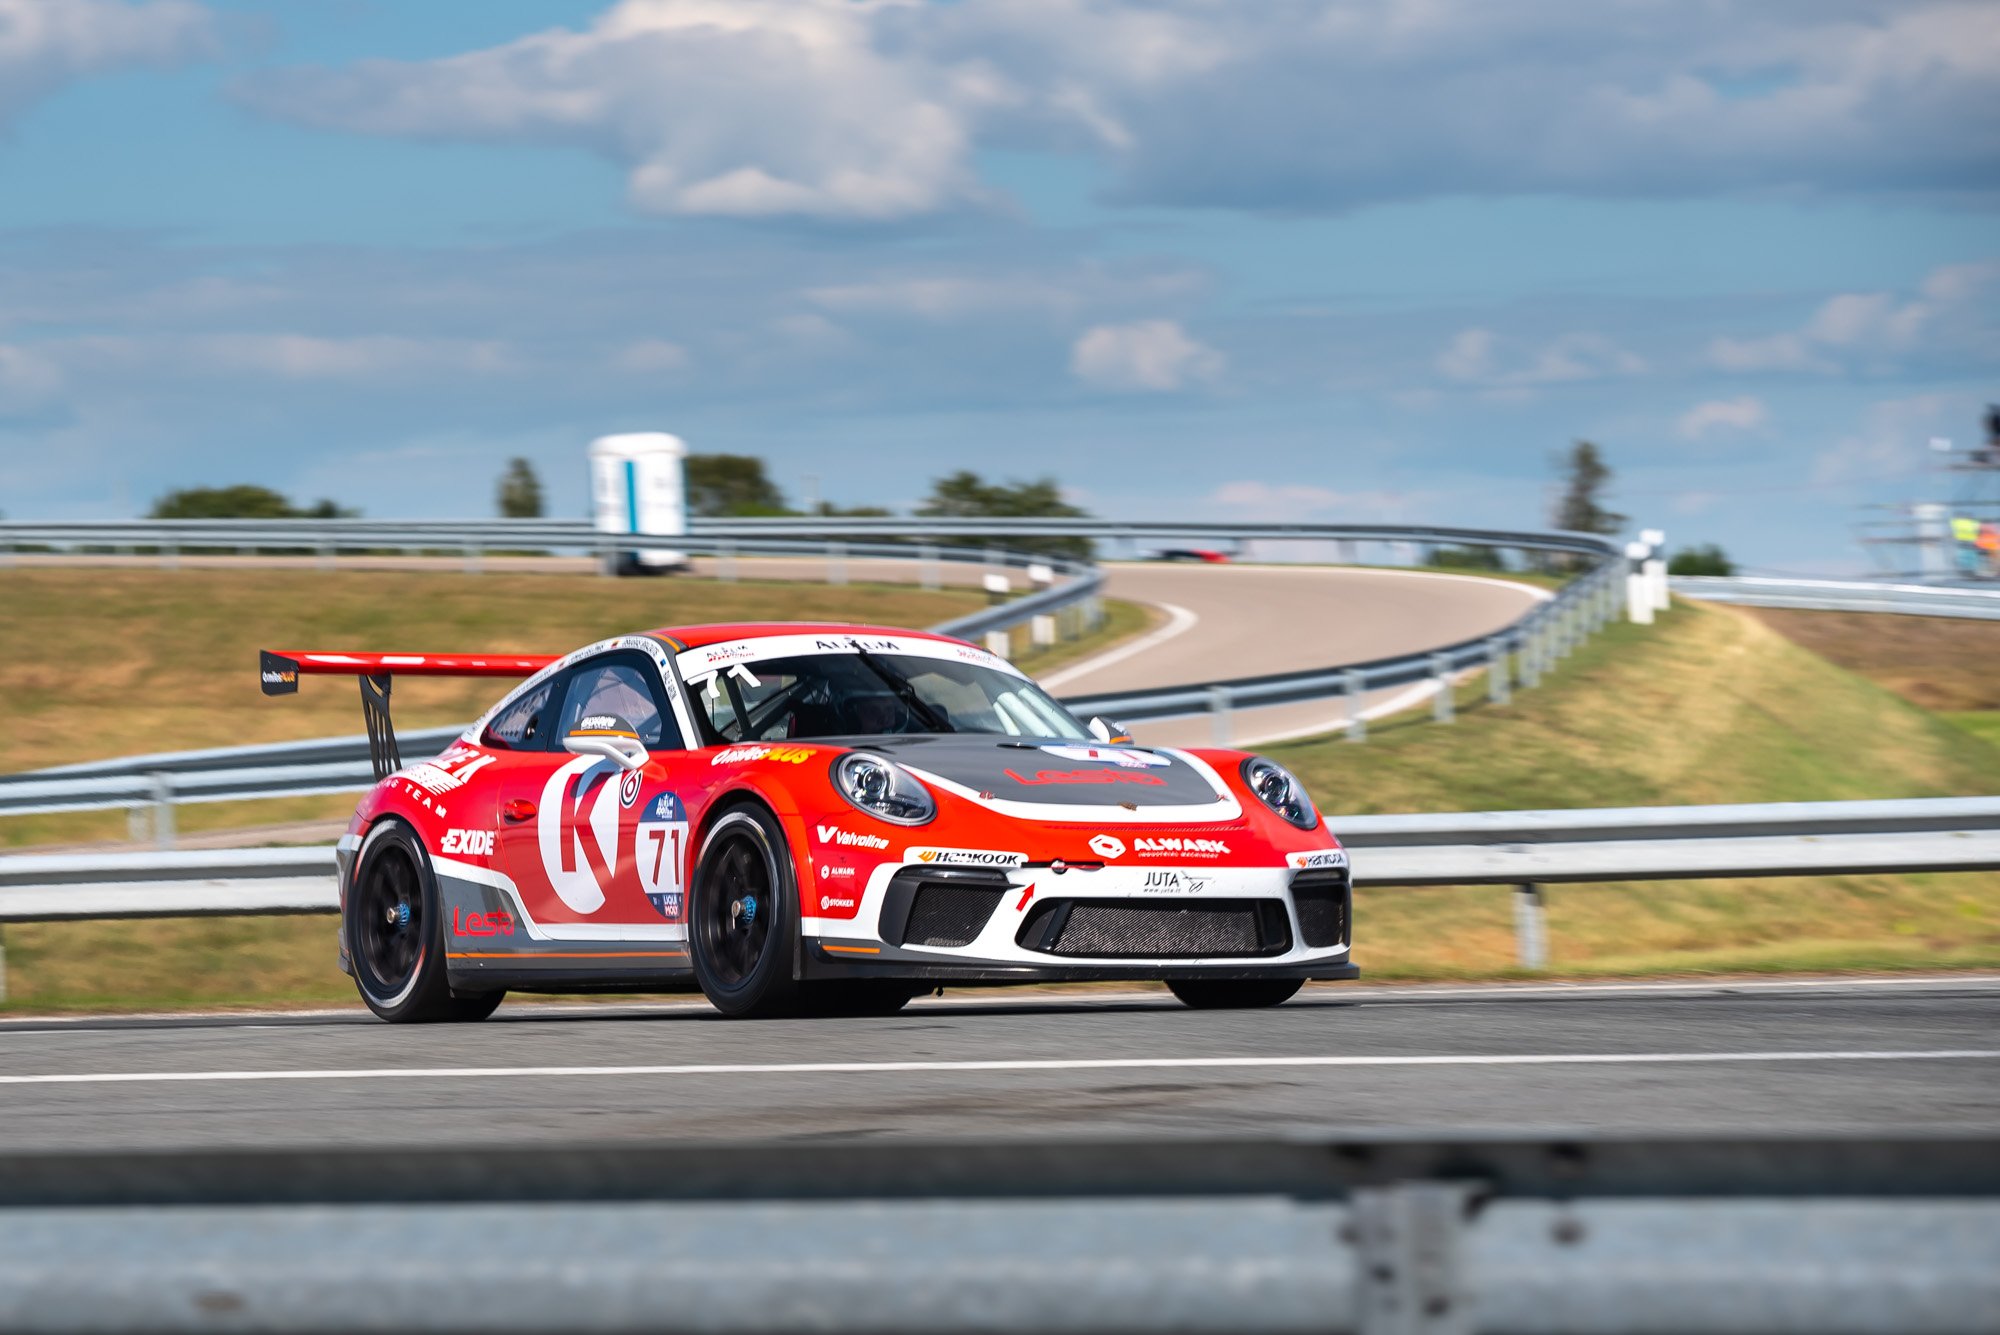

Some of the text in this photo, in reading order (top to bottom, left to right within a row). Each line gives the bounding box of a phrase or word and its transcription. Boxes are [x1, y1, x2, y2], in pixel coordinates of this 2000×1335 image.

[687, 663, 761, 699] 71
[404, 783, 447, 818] TEAM
[440, 828, 495, 856] EXIDE
[836, 831, 890, 850] Valvoline
[1134, 837, 1232, 855] ALWARK
[649, 829, 680, 886] 71
[830, 867, 856, 876] ALWARK
[1144, 871, 1181, 888] JUTA
[453, 904, 515, 937] Lesta
